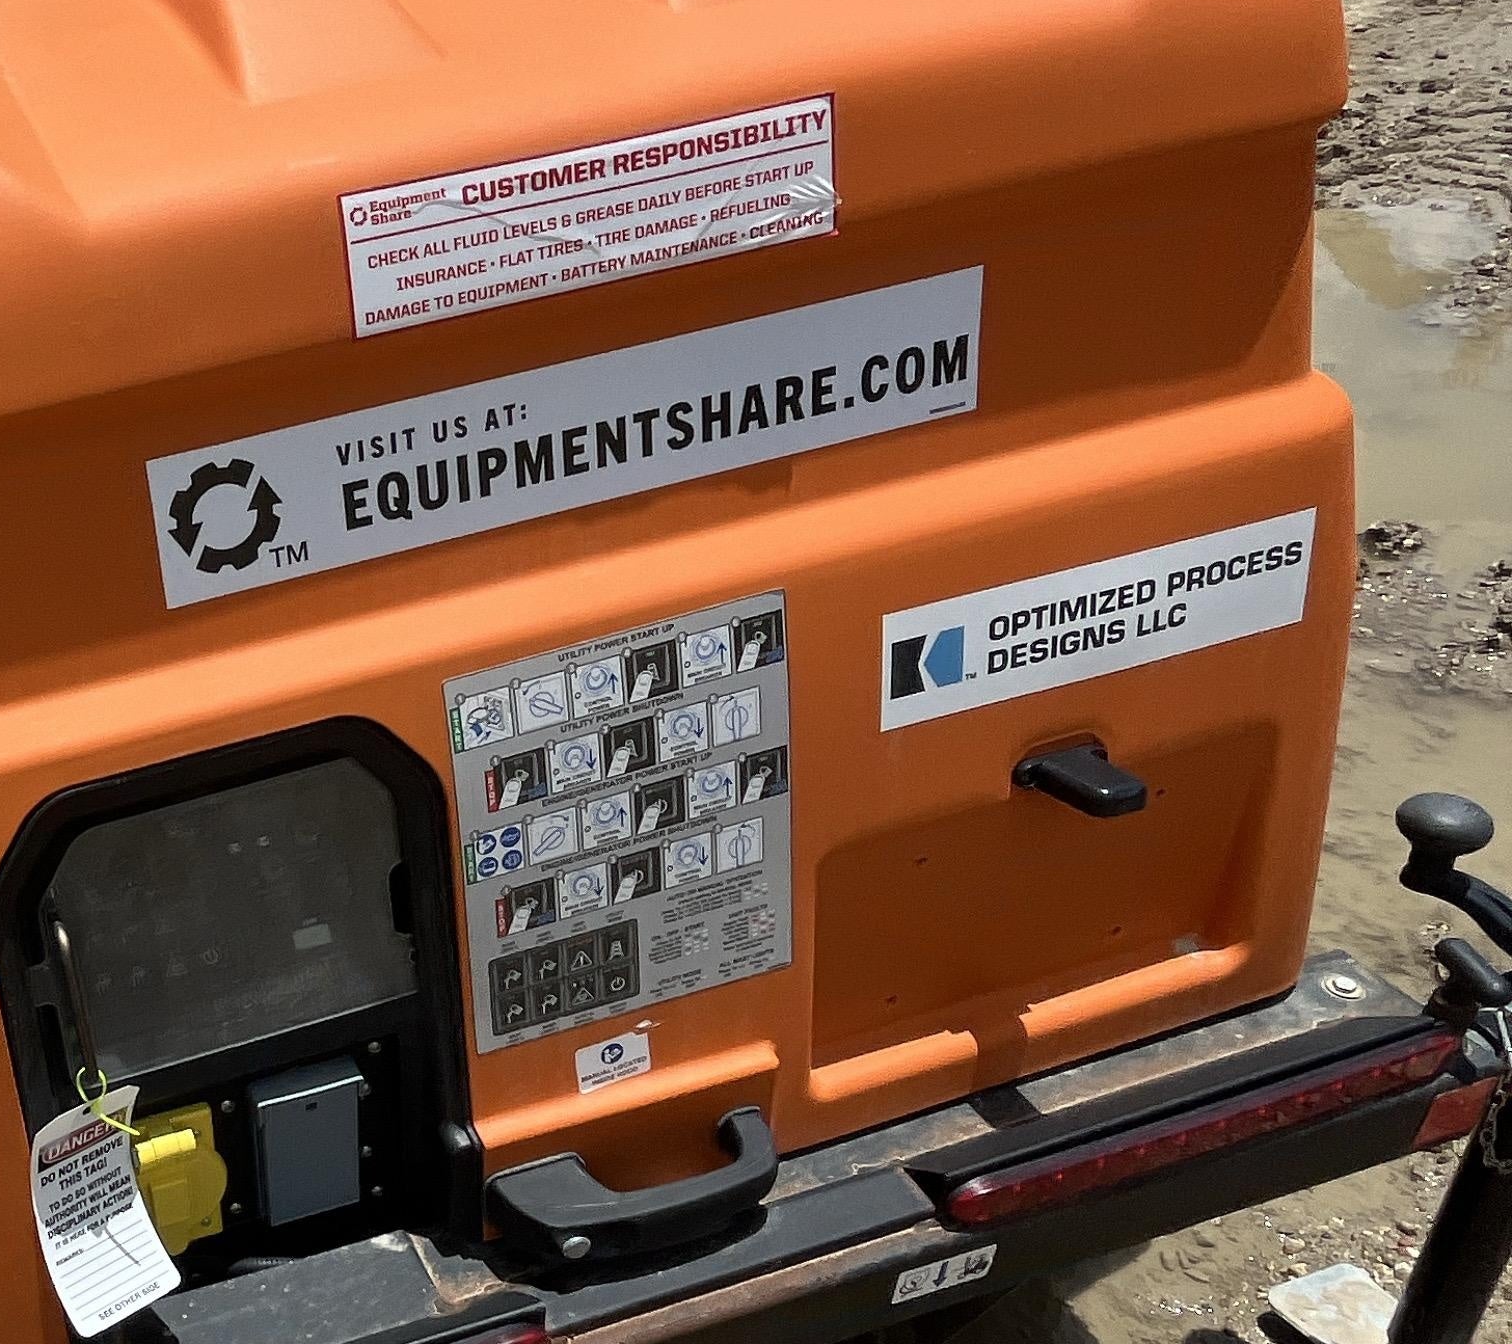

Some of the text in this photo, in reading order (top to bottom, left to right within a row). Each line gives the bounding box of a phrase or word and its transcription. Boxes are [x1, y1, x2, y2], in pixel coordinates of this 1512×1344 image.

[461, 109, 827, 206] CUSTOMER RESPONSIBILITY
[368, 246, 420, 269] CHECK
[423, 240, 450, 258] ALL
[454, 230, 499, 251] FLUID
[503, 217, 557, 240] LEVELS
[576, 201, 633, 226] GREASE
[638, 190, 682, 211] DAILY
[685, 178, 742, 201] BEFORE
[745, 165, 791, 188] START
[794, 160, 814, 177] UP
[369, 187, 447, 213] Equipment
[370, 209, 412, 226] Share
[365, 211, 823, 325] DAMAGE TO EQUIPMENT BATTERY MAINTENANCE CLEANING
[396, 193, 791, 292] INSURANCE FLAT TIRES TIRE DAMAGE REFUELING
[336, 403, 528, 466] VISIT US AT:
[341, 333, 970, 532] EQUIPMENTSHARE.COM
[268, 541, 310, 568] TM
[989, 540, 1304, 641] OPTIMIZED PROCESS
[557, 623, 675, 662] UTILITY POWER START UP
[986, 602, 1188, 675] DESIGNS LLC
[560, 717, 594, 733] UTILITY
[596, 707, 630, 720] POWER
[40, 1136, 124, 1187] DO NOT REMOVE
[59, 1172, 82, 1190] THIS
[45, 1174, 131, 1228] AUTHORITY WILL MEAN
[49, 1167, 122, 1213] TO DO SO WITHOUT
[48, 1204, 101, 1240] DISCIPLINARY
[98, 1282, 161, 1320] SEE OTHER SIDE
